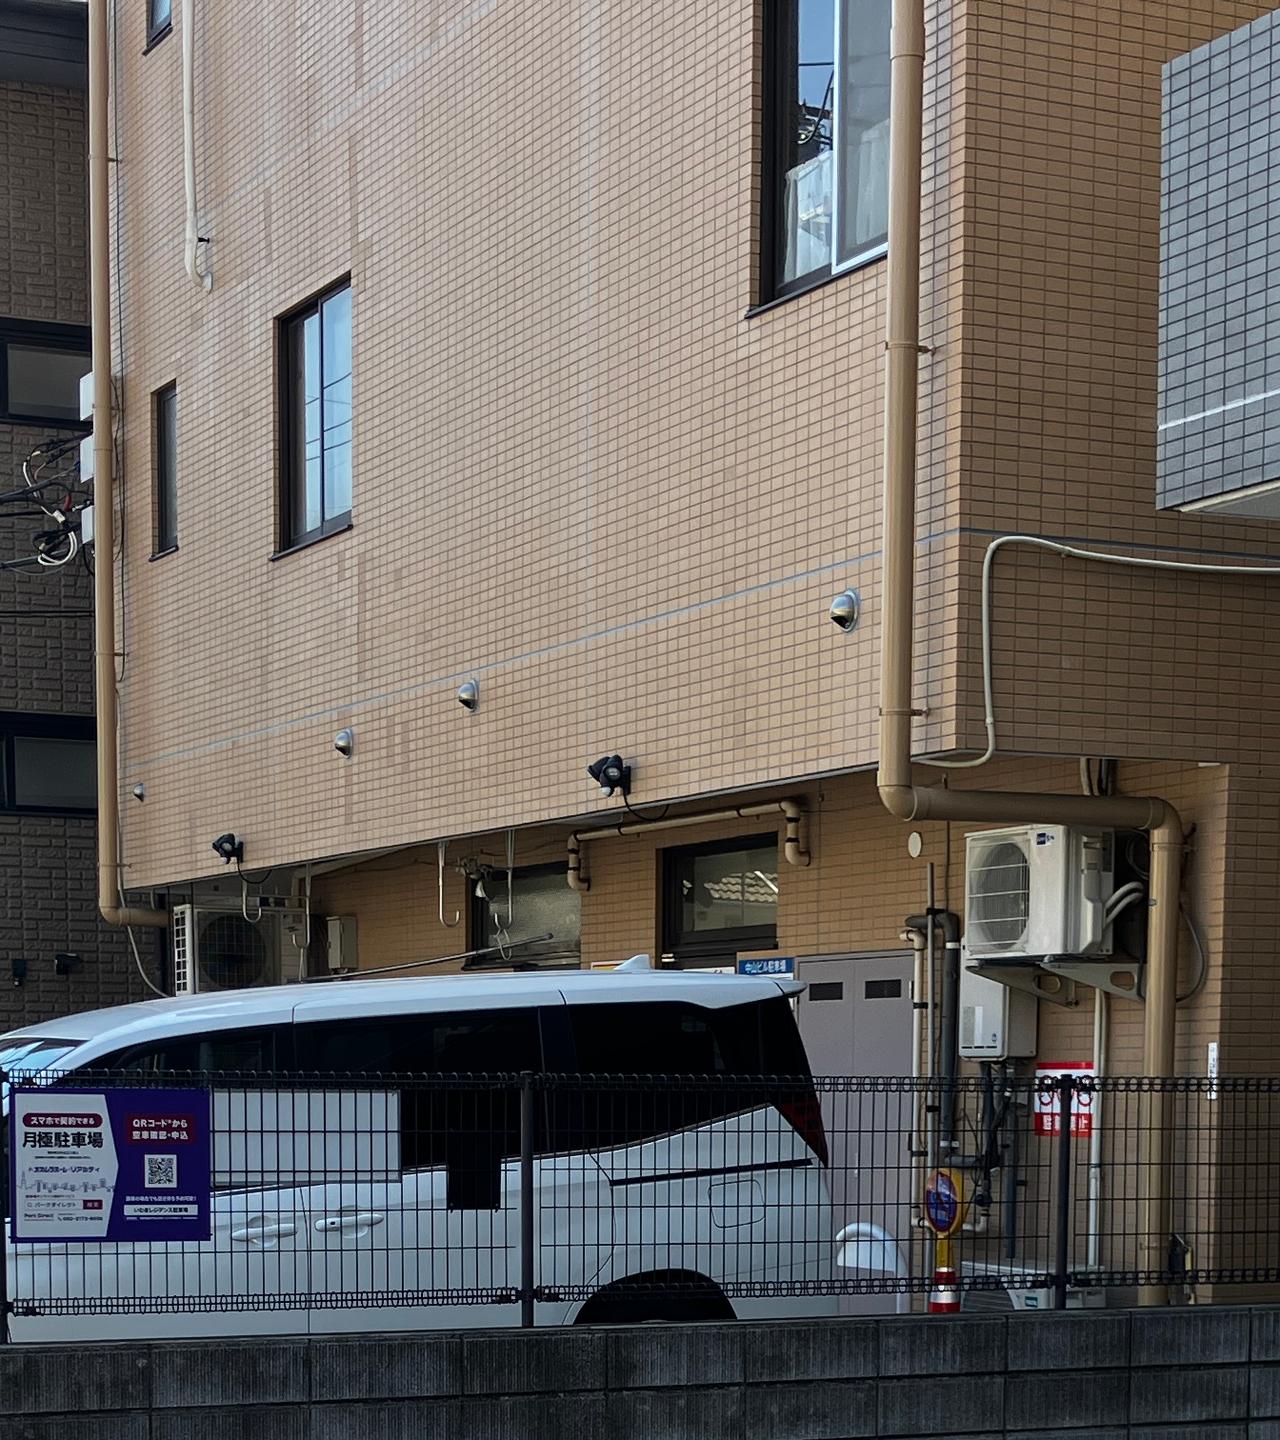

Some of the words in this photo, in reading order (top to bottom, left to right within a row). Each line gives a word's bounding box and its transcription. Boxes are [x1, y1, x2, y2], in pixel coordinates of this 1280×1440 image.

[31, 1116, 95, 1125] スマホで契約できる
[22, 1131, 104, 1148] 月極駐車場
